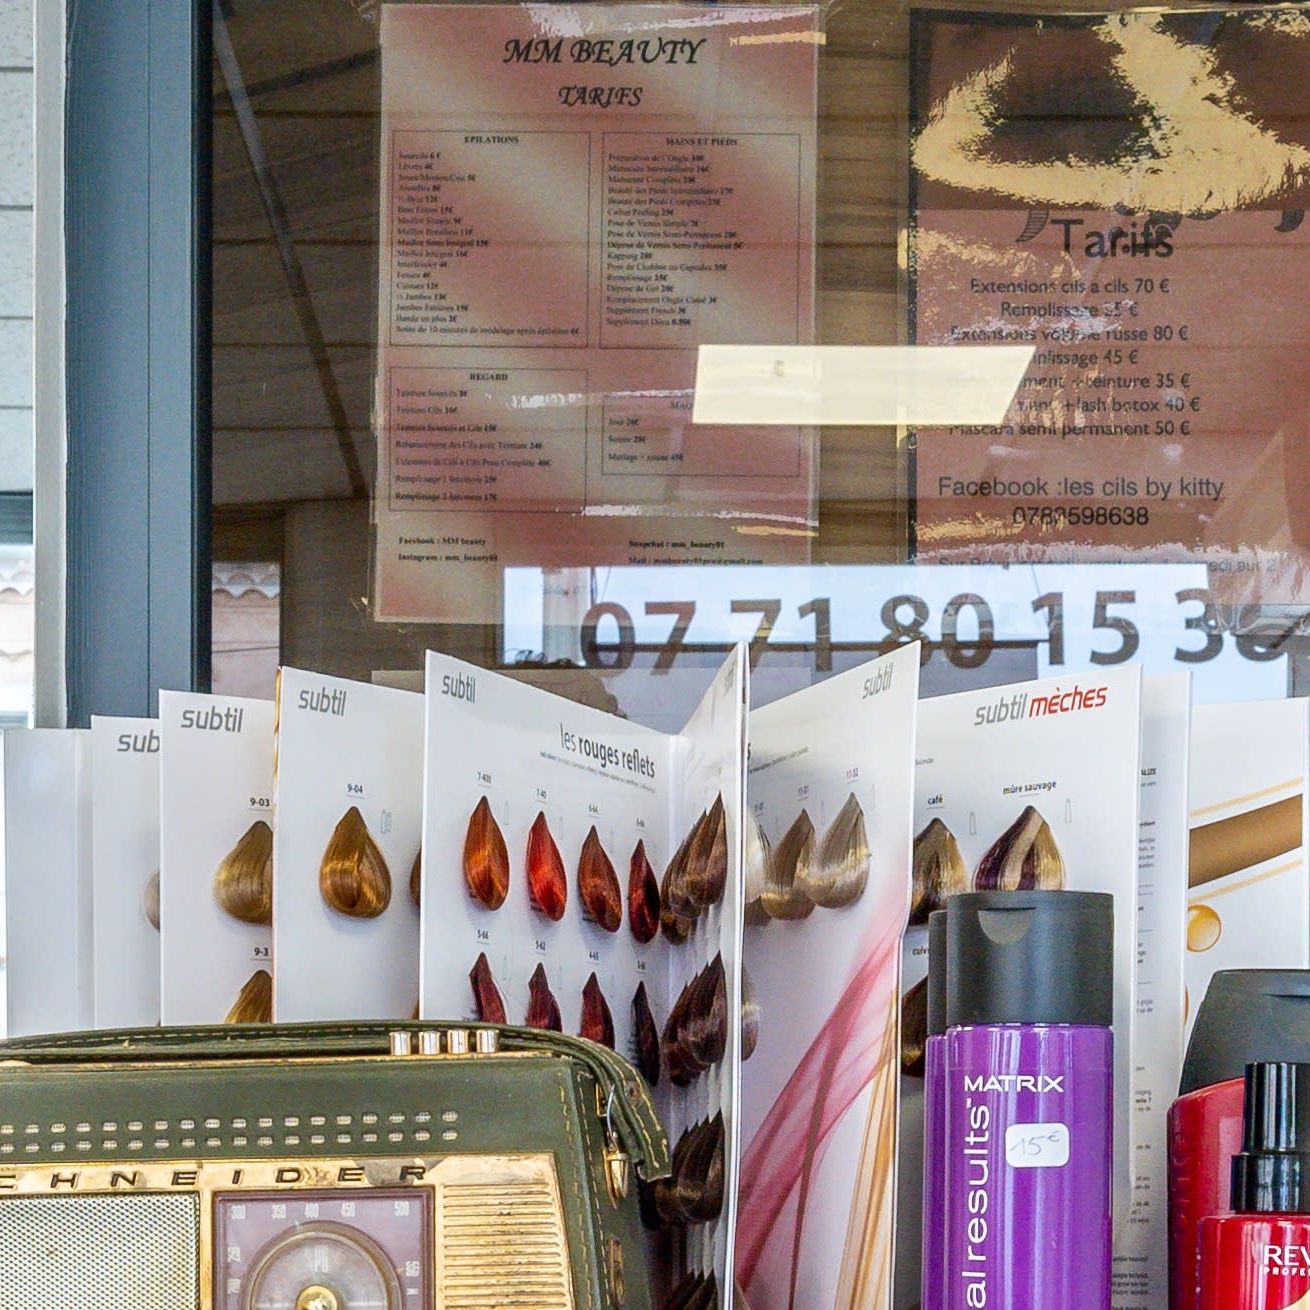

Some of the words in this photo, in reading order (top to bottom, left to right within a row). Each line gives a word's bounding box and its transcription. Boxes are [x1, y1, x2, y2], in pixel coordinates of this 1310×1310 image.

[503, 37, 564, 64] MM
[570, 36, 708, 66] BEAUTY
[558, 86, 644, 108] TARIFS
[1050, 218, 1174, 258] Tarifs
[971, 278, 1056, 293] Extensions
[1104, 278, 1129, 293] cils
[1135, 278, 1154, 293] 70
[1153, 326, 1173, 340] 80
[1103, 351, 1123, 364] 45
[1155, 374, 1175, 388] 35
[1062, 423, 1150, 439] permanent
[1155, 421, 1175, 435] 50
[939, 477, 1048, 496] Facebook
[1102, 477, 1138, 496] cils
[1146, 477, 1172, 501] by
[1180, 477, 1224, 501] kitty
[580, 601, 697, 677] 07
[730, 597, 833, 673] 71
[880, 591, 995, 670] 80
[1031, 589, 1141, 666] 15
[441, 672, 476, 704] subtil
[862, 663, 894, 700] subtil
[298, 687, 347, 717] subtil
[974, 693, 1028, 726] subtil
[1029, 686, 1108, 718] mèches
[181, 706, 243, 733] subtil
[117, 729, 160, 753] sub
[560, 723, 576, 753] les
[578, 737, 620, 768] rouges
[621, 749, 656, 779] reflets
[347, 783, 363, 794] 9-04
[927, 794, 944, 806] café
[249, 797, 270, 807] 9-03
[254, 947, 269, 957] 9-3
[963, 1075, 1065, 1093] MATRIX
